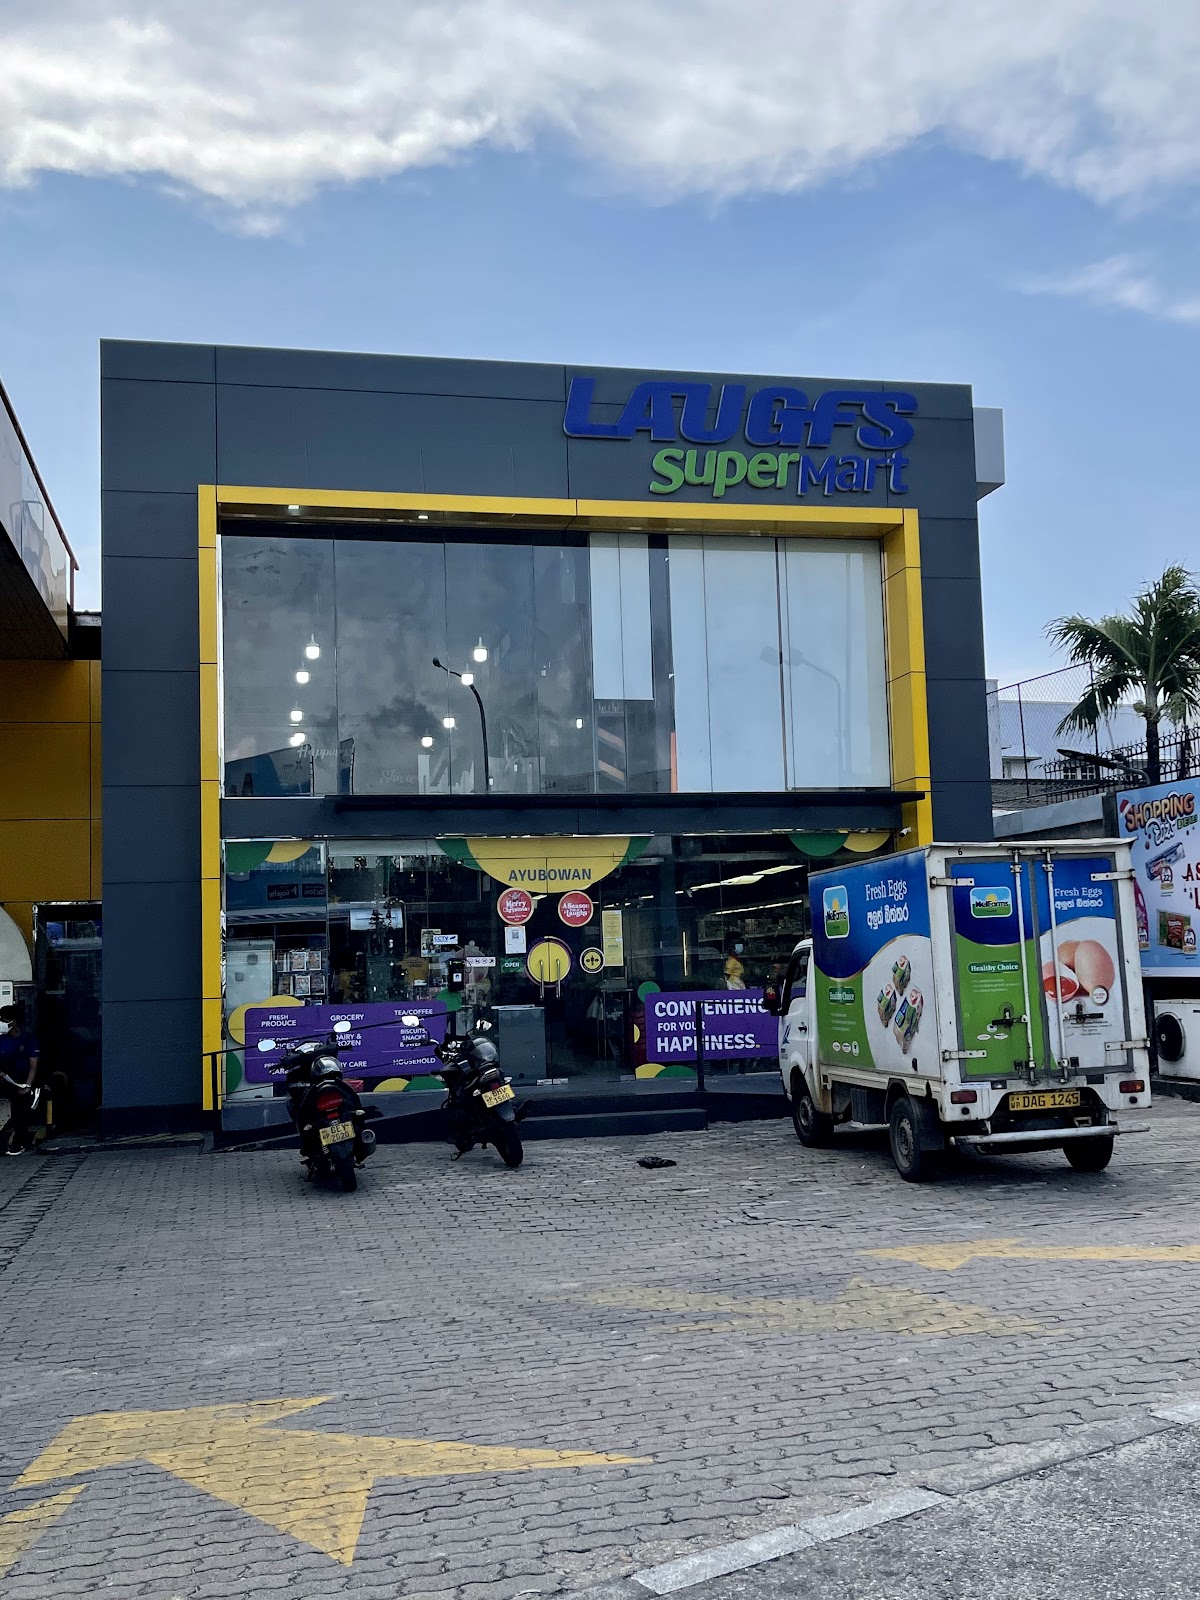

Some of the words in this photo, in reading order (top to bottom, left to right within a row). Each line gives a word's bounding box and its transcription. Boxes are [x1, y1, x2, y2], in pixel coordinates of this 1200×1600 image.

[563, 376, 919, 450] LAUGFS
[1125, 792, 1195, 831] SHOPPING
[957, 847, 963, 856] 6
[508, 868, 592, 881] AYUBOWAN
[865, 880, 887, 901] Fresh
[887, 879, 908, 901] Eggs
[1053, 887, 1080, 897] Fresh
[1081, 887, 1103, 898] Eggs
[505, 900, 527, 909] Merry
[394, 1008, 433, 1016] TEA/COFFEE
[657, 1022, 677, 1031] FOR
[1022, 1095, 1046, 1108] DAG
[1050, 1093, 1080, 1107] 1245
